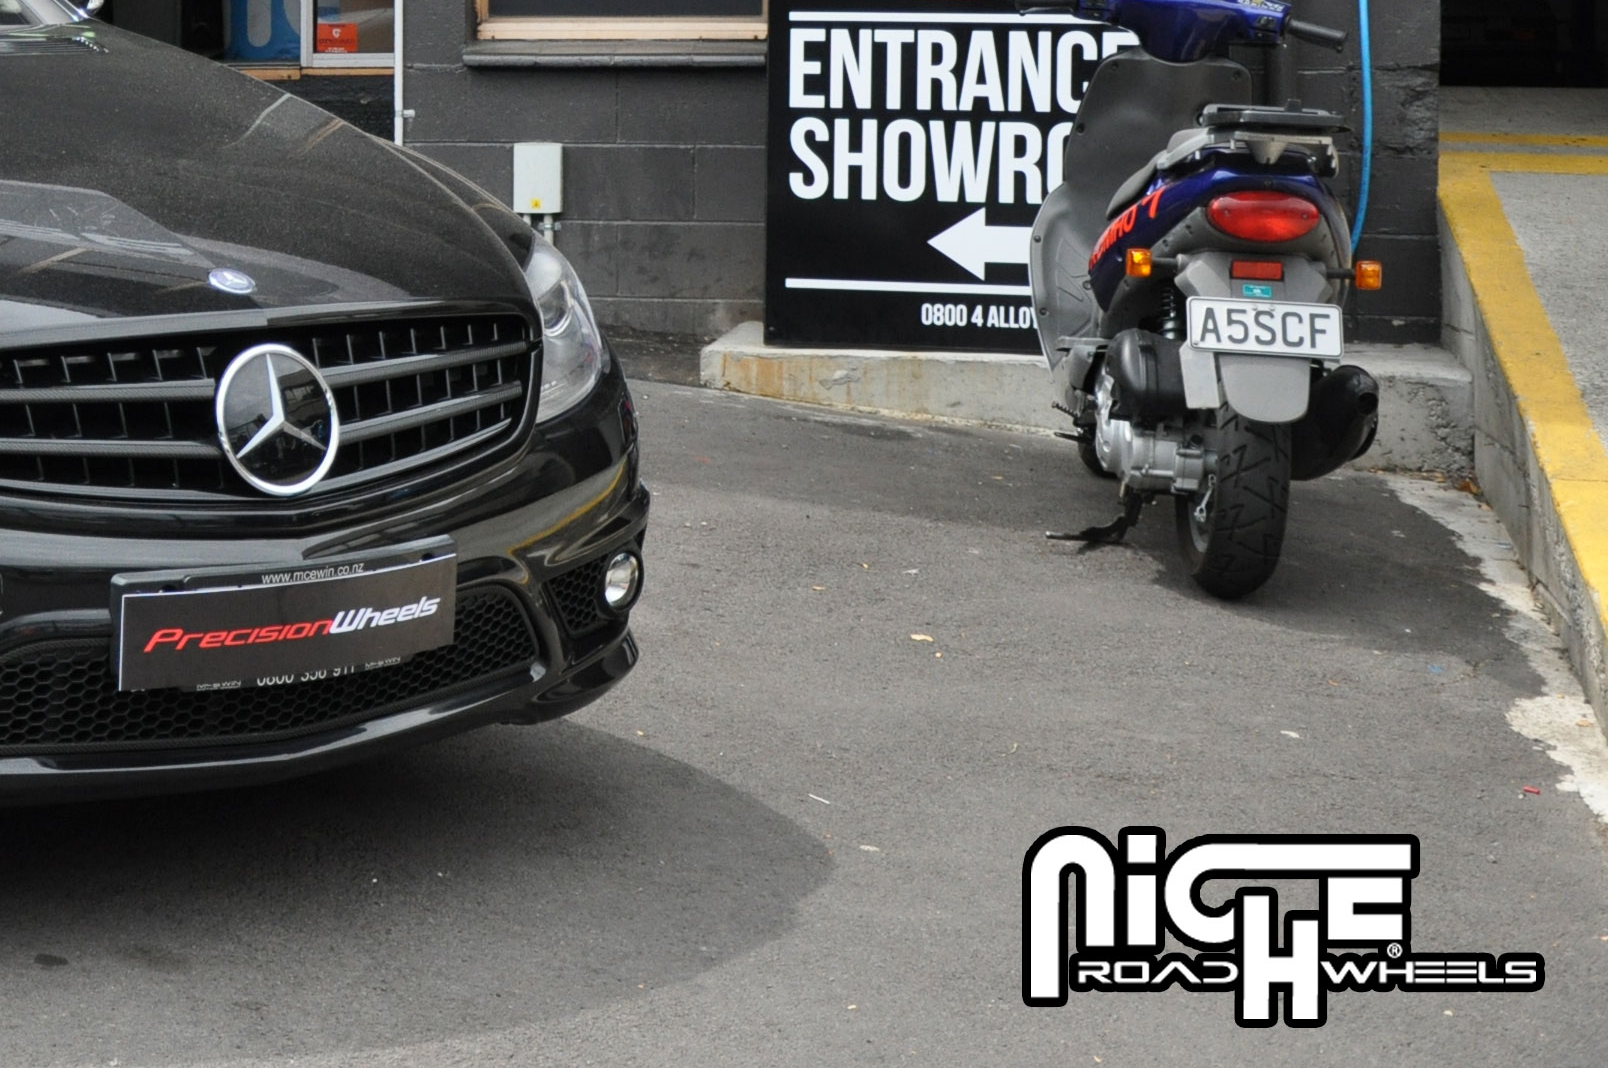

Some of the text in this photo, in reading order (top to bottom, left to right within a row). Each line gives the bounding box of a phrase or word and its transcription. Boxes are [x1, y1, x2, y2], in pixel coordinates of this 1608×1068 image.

[921, 303, 968, 327] 0800
[971, 305, 984, 327] 4
[1200, 307, 1331, 349] A5SCF
[261, 563, 365, 584] www.mcewin.co.nz
[143, 596, 440, 653] PrecisionWheels
